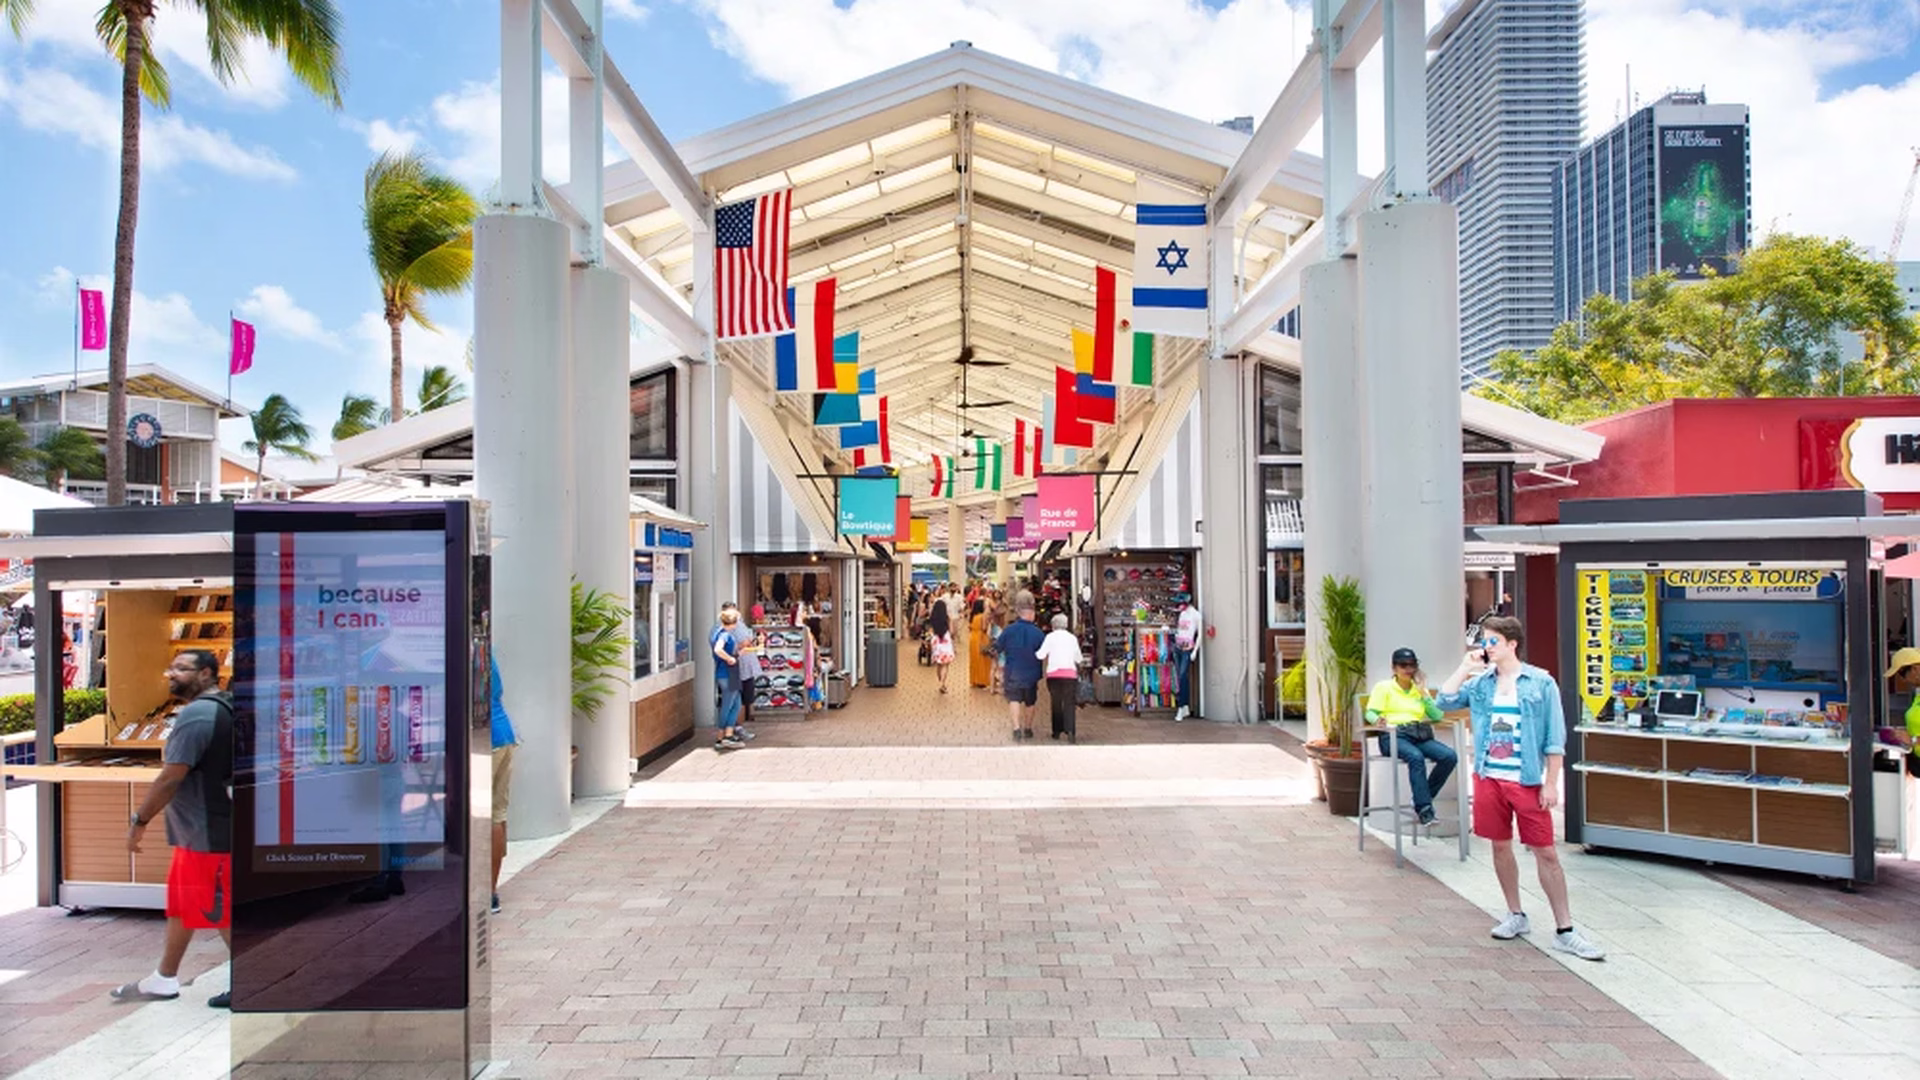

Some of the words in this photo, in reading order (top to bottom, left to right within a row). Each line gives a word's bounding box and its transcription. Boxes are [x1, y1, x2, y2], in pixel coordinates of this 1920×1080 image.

[842, 510, 855, 520] Le
[1040, 508, 1061, 518] Rue
[1063, 508, 1078, 518] de
[842, 520, 894, 532] Bowtique
[1040, 519, 1077, 528] France
[1668, 569, 1737, 584] CRUISES
[1740, 570, 1754, 584] &
[1759, 569, 1820, 584] TOURS
[318, 584, 421, 604] because
[1585, 574, 1602, 648] TICKETS
[318, 609, 325, 629] I
[333, 610, 385, 629] can.
[1586, 654, 1604, 696] HERE
[266, 853, 286, 863] Click
[287, 853, 314, 863] Screen
[315, 853, 329, 862] For
[330, 853, 367, 864] Directory
